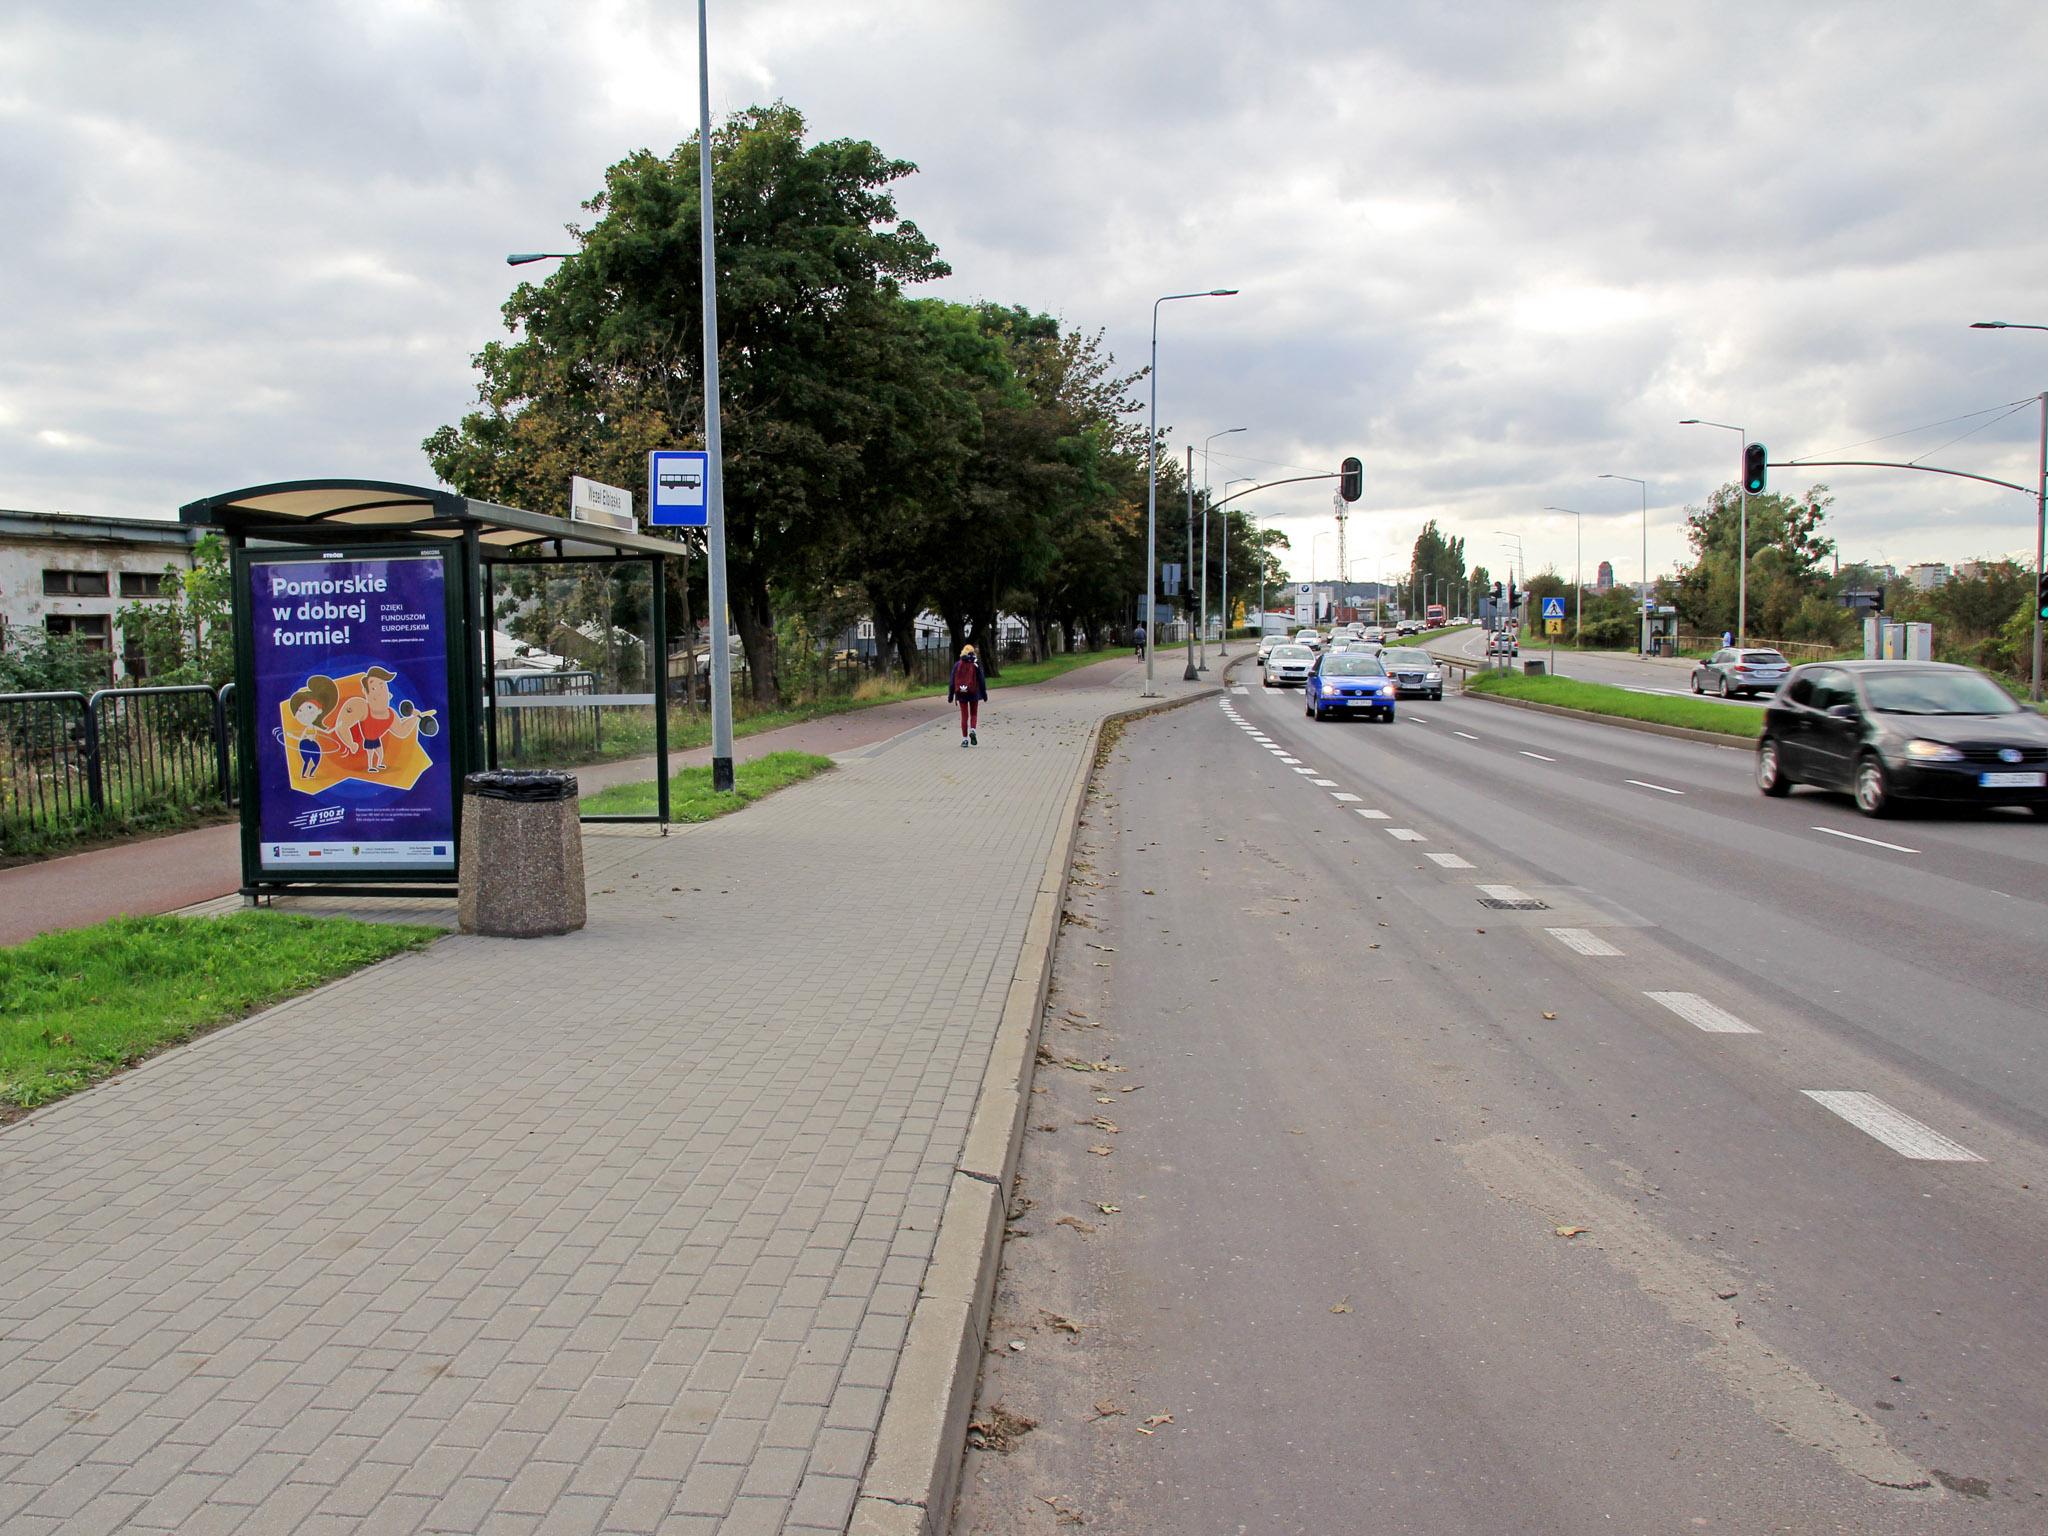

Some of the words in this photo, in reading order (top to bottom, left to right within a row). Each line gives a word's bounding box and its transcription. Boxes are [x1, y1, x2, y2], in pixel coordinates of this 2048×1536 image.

[272, 574, 387, 596] Pomorskie
[273, 607, 291, 621] w
[297, 599, 366, 623] dobrej
[380, 604, 403, 612] DZIĘKI
[380, 613, 426, 622] FUNDUSZOM
[381, 623, 430, 632] EUROPEJSKIM
[273, 625, 350, 646] formie!
